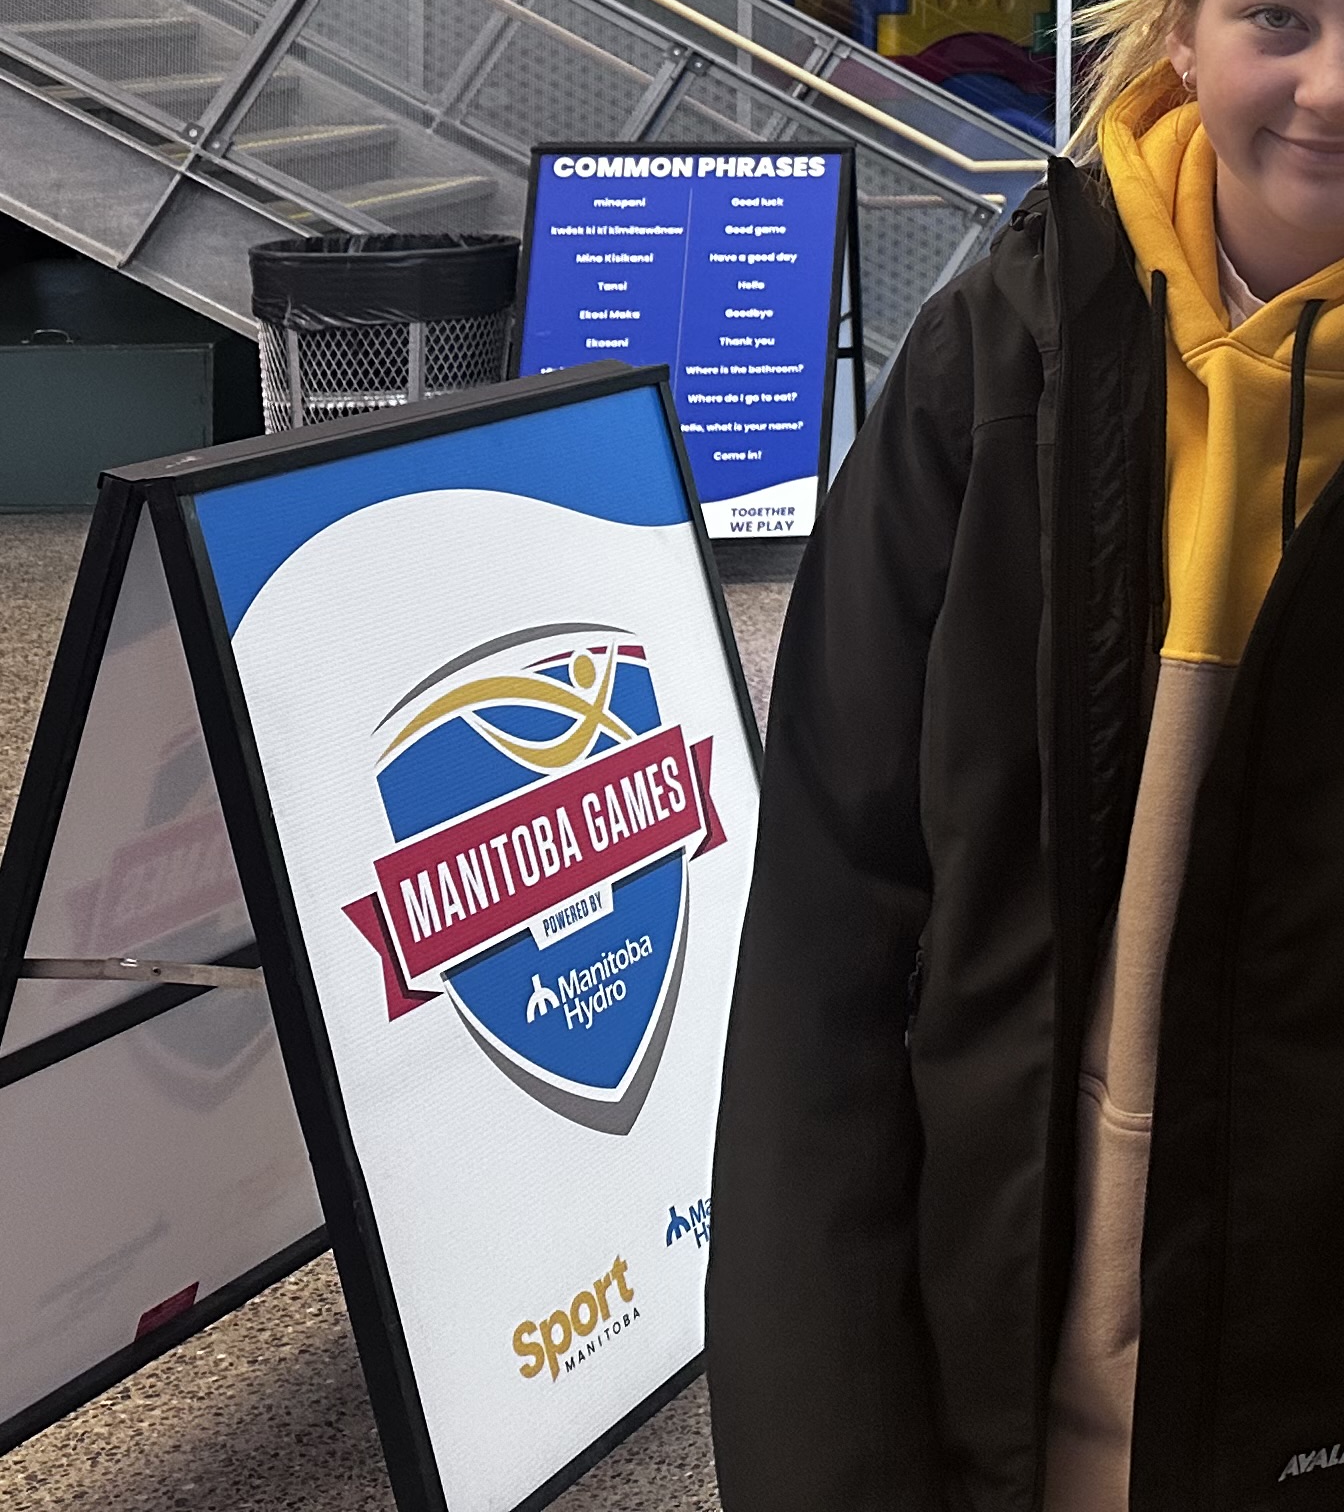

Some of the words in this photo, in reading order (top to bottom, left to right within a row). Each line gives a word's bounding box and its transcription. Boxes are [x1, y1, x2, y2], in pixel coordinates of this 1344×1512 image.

[553, 156, 694, 178] COMMON
[697, 156, 826, 178] PHRASES
[731, 197, 760, 207] Good
[761, 196, 784, 207] luck
[724, 224, 754, 235] Good
[754, 225, 787, 237] game
[709, 253, 738, 263] Have
[738, 253, 746, 262] a
[747, 252, 775, 265] good
[775, 252, 798, 264] day
[737, 280, 766, 290] Hello
[724, 308, 774, 320] Goodbye
[719, 336, 753, 347] Thank
[753, 337, 776, 349] you
[685, 365, 719, 375] Where
[719, 364, 729, 375] is
[729, 365, 747, 375] the
[747, 363, 805, 375] bathroom?
[687, 393, 723, 404] Where
[724, 393, 739, 403] do
[745, 394, 760, 406] go
[760, 393, 773, 402] to
[773, 391, 798, 402] eat?
[706, 422, 733, 432] what
[733, 421, 743, 432] is
[743, 423, 768, 434] your
[768, 420, 804, 431] name?
[713, 451, 746, 461] Come
[747, 449, 763, 460] in!
[731, 506, 796, 517] TOGETHER
[730, 520, 753, 533] WE
[756, 520, 795, 532] PLAY
[400, 806, 583, 944] MANITOBA
[581, 755, 687, 853] GAMES
[542, 898, 590, 938] POWERED
[587, 890, 603, 912] BY
[557, 934, 653, 1004] Manitoba
[563, 978, 627, 1030] Hydro
[512, 1253, 635, 1383] Sport
[564, 1307, 641, 1373] MANITOBA
